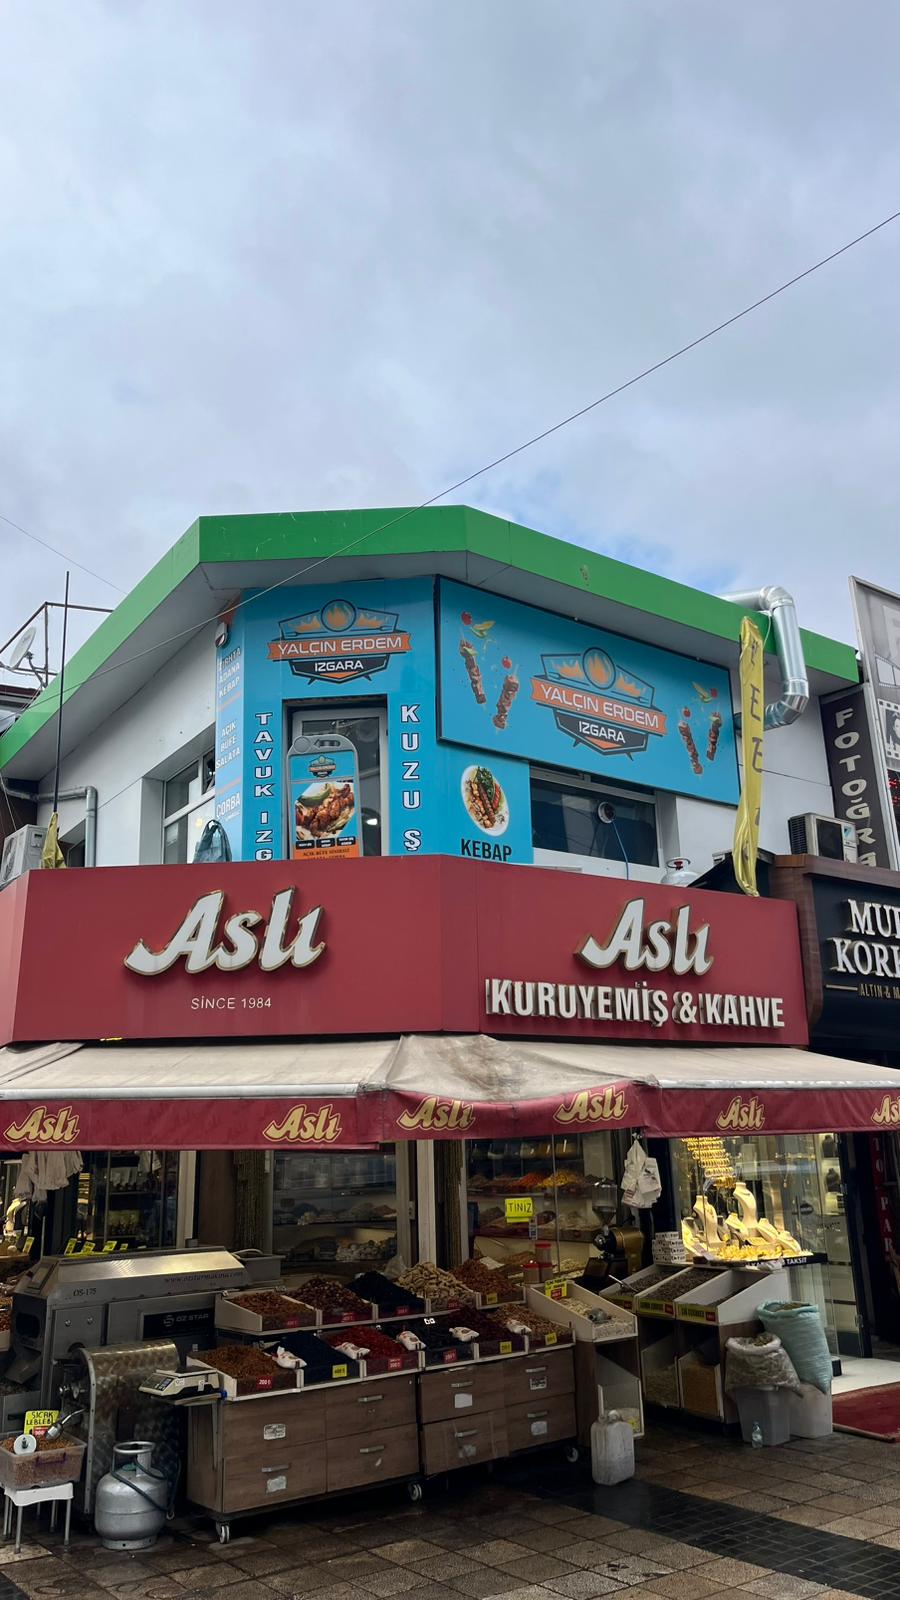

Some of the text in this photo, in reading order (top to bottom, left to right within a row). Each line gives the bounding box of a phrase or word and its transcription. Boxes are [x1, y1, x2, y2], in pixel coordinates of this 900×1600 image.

[278, 636, 402, 656] YALÇIN ERDEM
[314, 660, 364, 672] IZGARA
[540, 683, 659, 729] YALÇIN ERDEM
[578, 720, 626, 744] IZGARA
[215, 746, 240, 769] SALATA
[255, 712, 275, 797] TAVUK
[400, 704, 421, 810] KUZU
[461, 837, 512, 862] KEBAP
[123, 885, 326, 976] Aslı
[574, 897, 713, 976] Aslı
[240, 997, 272, 1009] 1984
[485, 978, 785, 1028] KURUYEMİŞ & KAHVE
[859, 983, 883, 998] ALTIN
